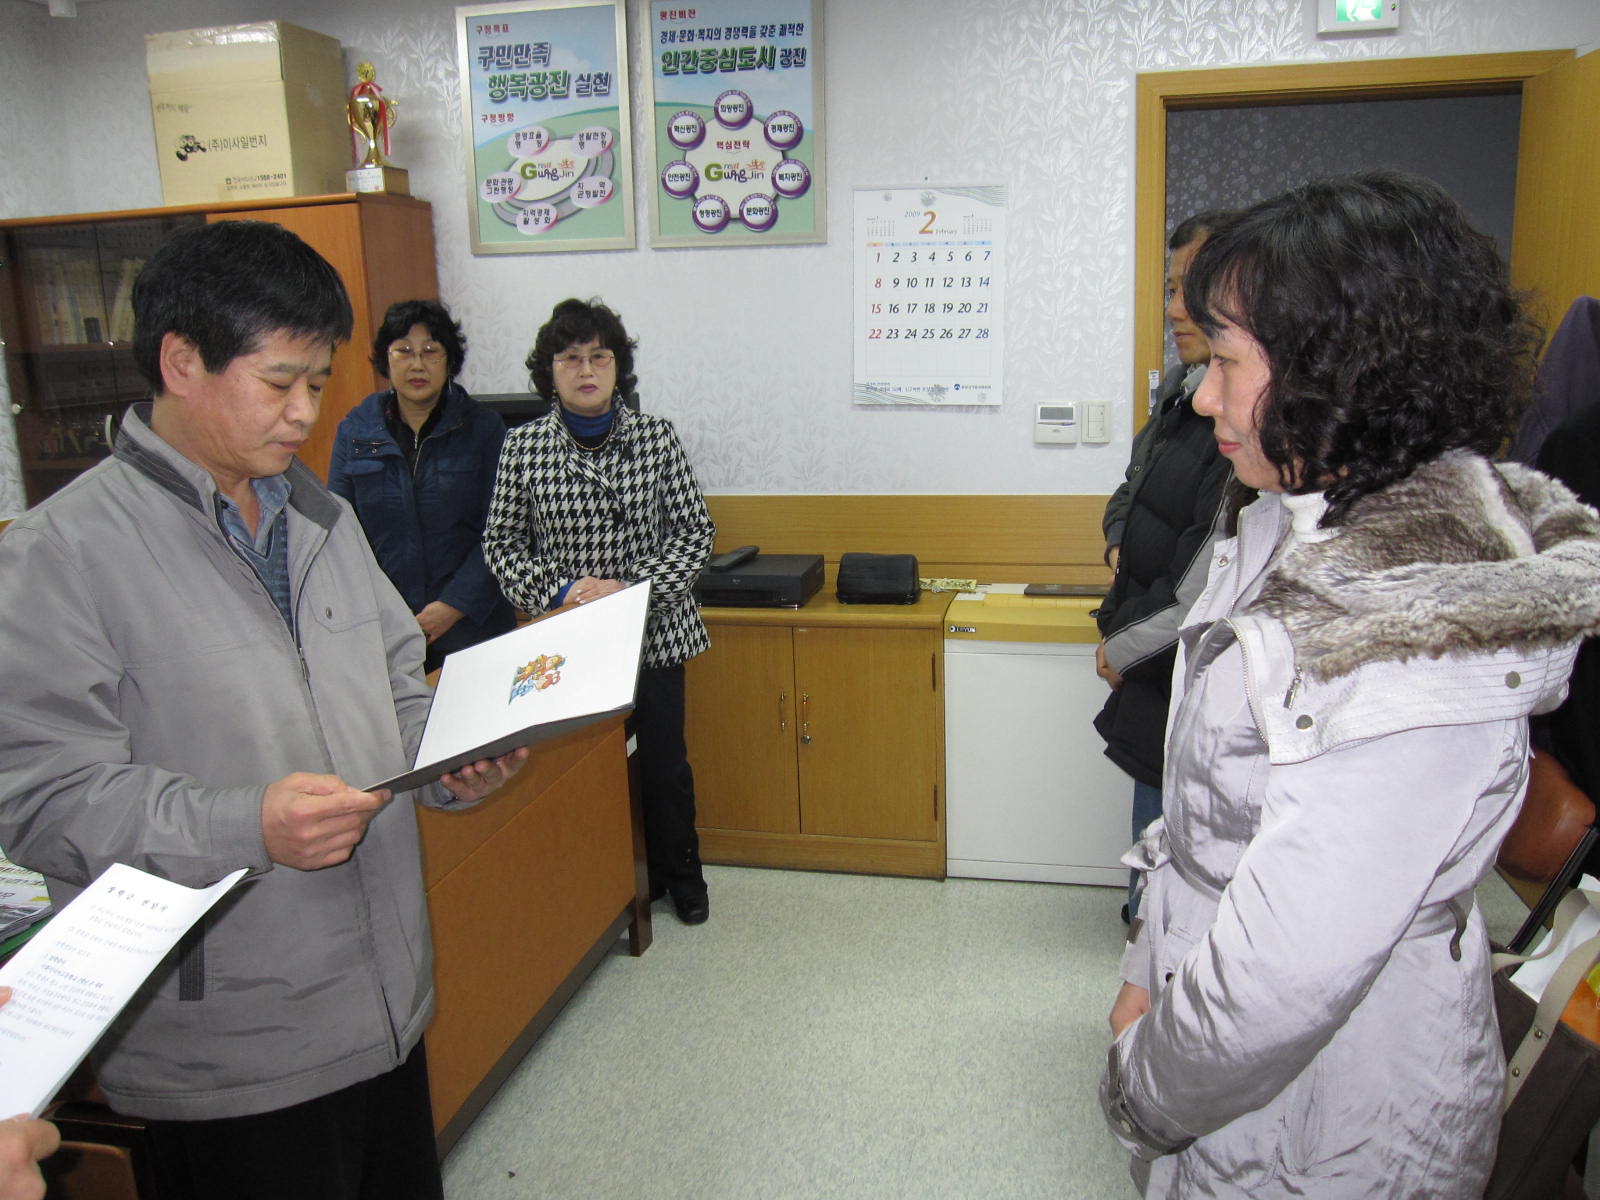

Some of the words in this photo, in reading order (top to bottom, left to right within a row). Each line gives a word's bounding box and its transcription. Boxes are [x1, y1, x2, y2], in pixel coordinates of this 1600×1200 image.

[724, 25, 757, 40] 경쟁력을
[760, 24, 776, 38] 갖춘
[478, 42, 550, 69] 구민만족
[661, 45, 776, 75] 인간중심도시
[780, 47, 806, 67] 광진
[488, 70, 569, 101] 행복광진
[575, 72, 611, 96] 실현
[208, 134, 267, 152] (주)이사일번지
[716, 140, 750, 150] 핵심전략
[919, 210, 937, 235] 2
[876, 253, 881, 263] 1
[892, 252, 900, 263] 2
[910, 252, 918, 263] 3
[928, 252, 936, 262] 4
[947, 251, 954, 262] 5
[964, 251, 972, 261] 6
[983, 250, 991, 261] 7
[874, 278, 882, 288] 8
[892, 278, 900, 288] 9
[906, 278, 918, 288] 10
[925, 278, 934, 288] 11
[943, 277, 954, 288] 12
[961, 277, 972, 288] 13
[979, 277, 990, 287] 14
[871, 303, 882, 314] 15
[889, 303, 900, 314] 16
[907, 303, 918, 314] 17
[924, 303, 936, 314] 18
[942, 303, 954, 313] 19
[958, 303, 972, 313] 20
[976, 303, 988, 313] 21
[868, 329, 882, 339] 22
[886, 329, 899, 339] 23
[904, 329, 917, 339] 24
[921, 329, 935, 339] 25
[940, 329, 953, 339] 26
[958, 329, 972, 339] 27
[976, 328, 990, 339] 28
